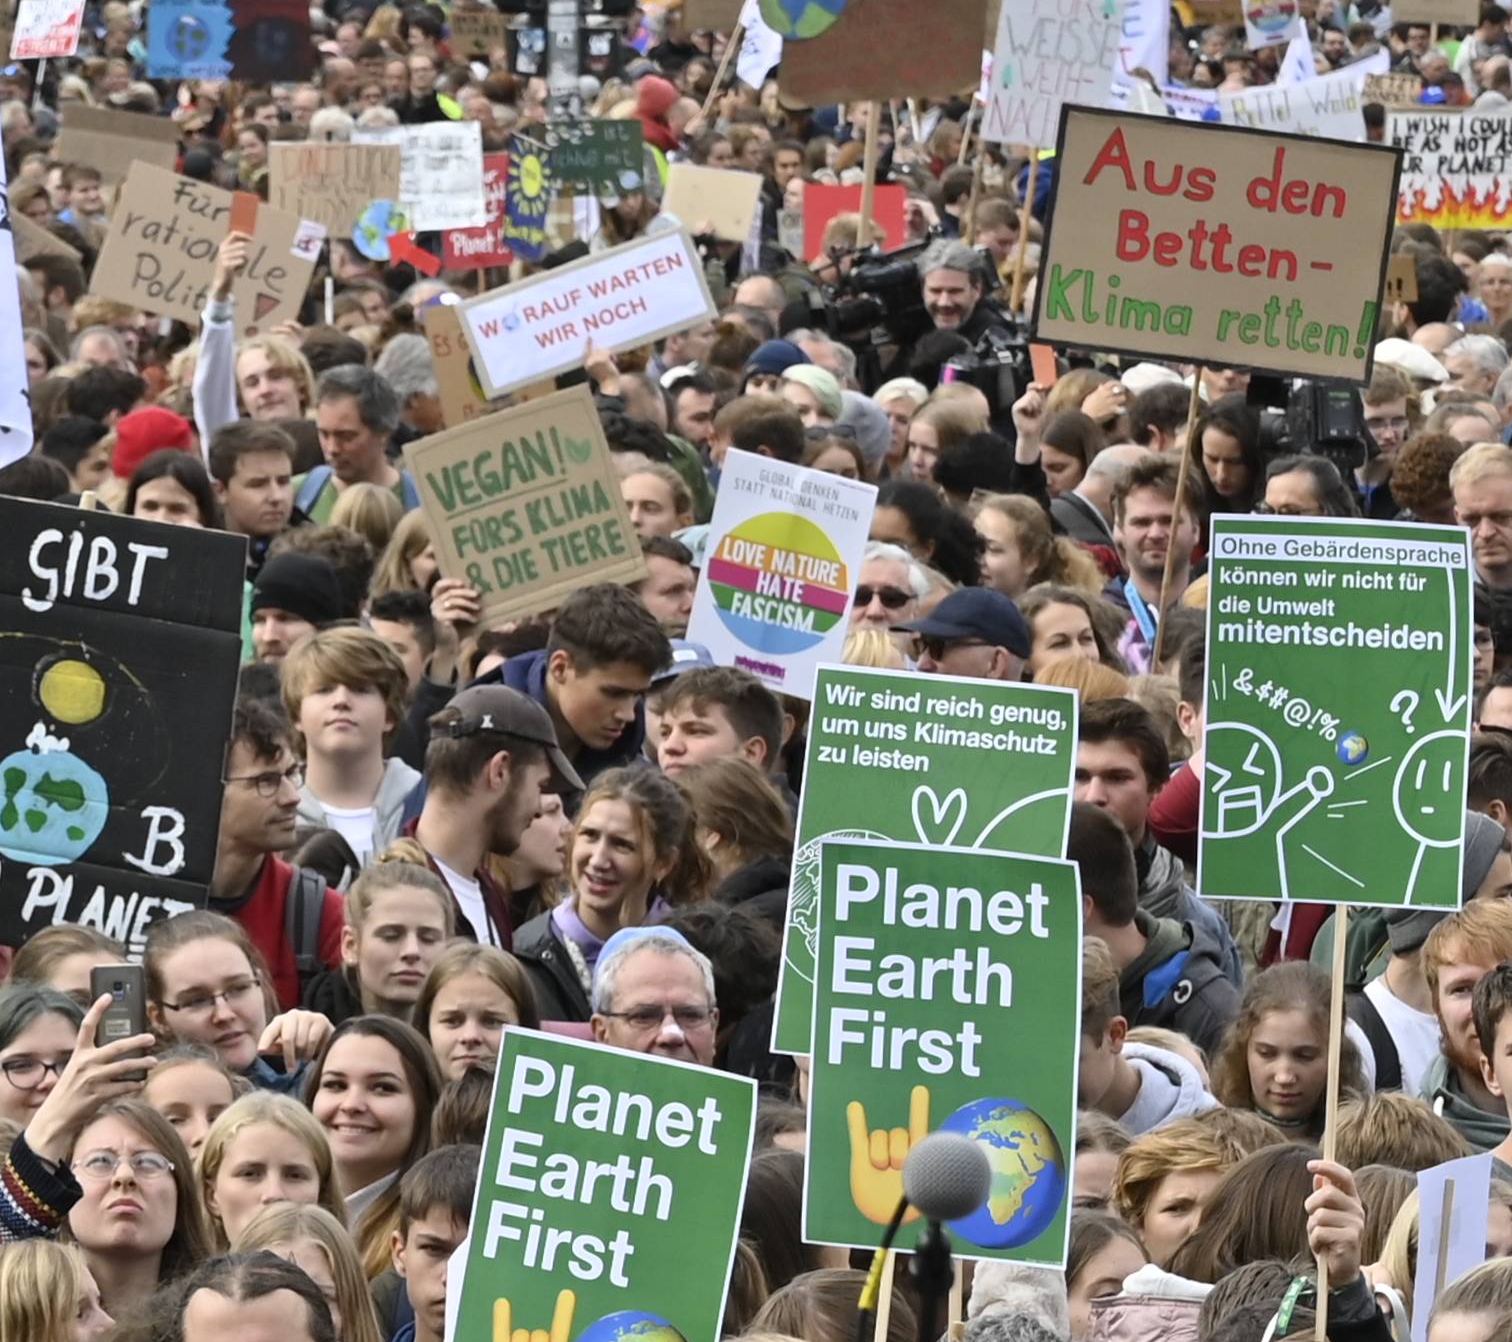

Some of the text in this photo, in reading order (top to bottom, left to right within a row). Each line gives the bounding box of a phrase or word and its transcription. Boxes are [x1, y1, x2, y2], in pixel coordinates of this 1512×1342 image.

[1407, 117, 1449, 134] WISH
[1421, 136, 1441, 153] AS
[1083, 126, 1348, 219] Aus den
[1402, 155, 1505, 175] UR PLANET
[1046, 264, 1377, 361] Klima retten!
[426, 426, 567, 514] VEGAN!
[452, 479, 610, 559] FÜRS KLIMA
[21, 529, 169, 613] GIBT
[466, 518, 627, 595] & DIE TIERE
[722, 537, 840, 586] LOVE NATURE
[1219, 566, 1426, 592] können wir nicht für
[1221, 537, 1462, 566] Ohne Gebärdensprache
[731, 591, 815, 633] FASCISM
[756, 570, 805, 604] HATE
[1218, 597, 1335, 617] die Umwelt
[1218, 618, 1444, 651] mitentscheiden
[821, 716, 1057, 755] um uns Klimaschutz
[826, 683, 1067, 731] Wir sind reich genug,
[817, 744, 929, 772] zu leisten
[122, 806, 185, 876] B
[833, 863, 1049, 940] Planet
[831, 936, 1014, 1008] Earth
[827, 1008, 983, 1078] First
[505, 1054, 722, 1156] Planet
[493, 1128, 675, 1223] Earth
[480, 1200, 635, 1289] First
